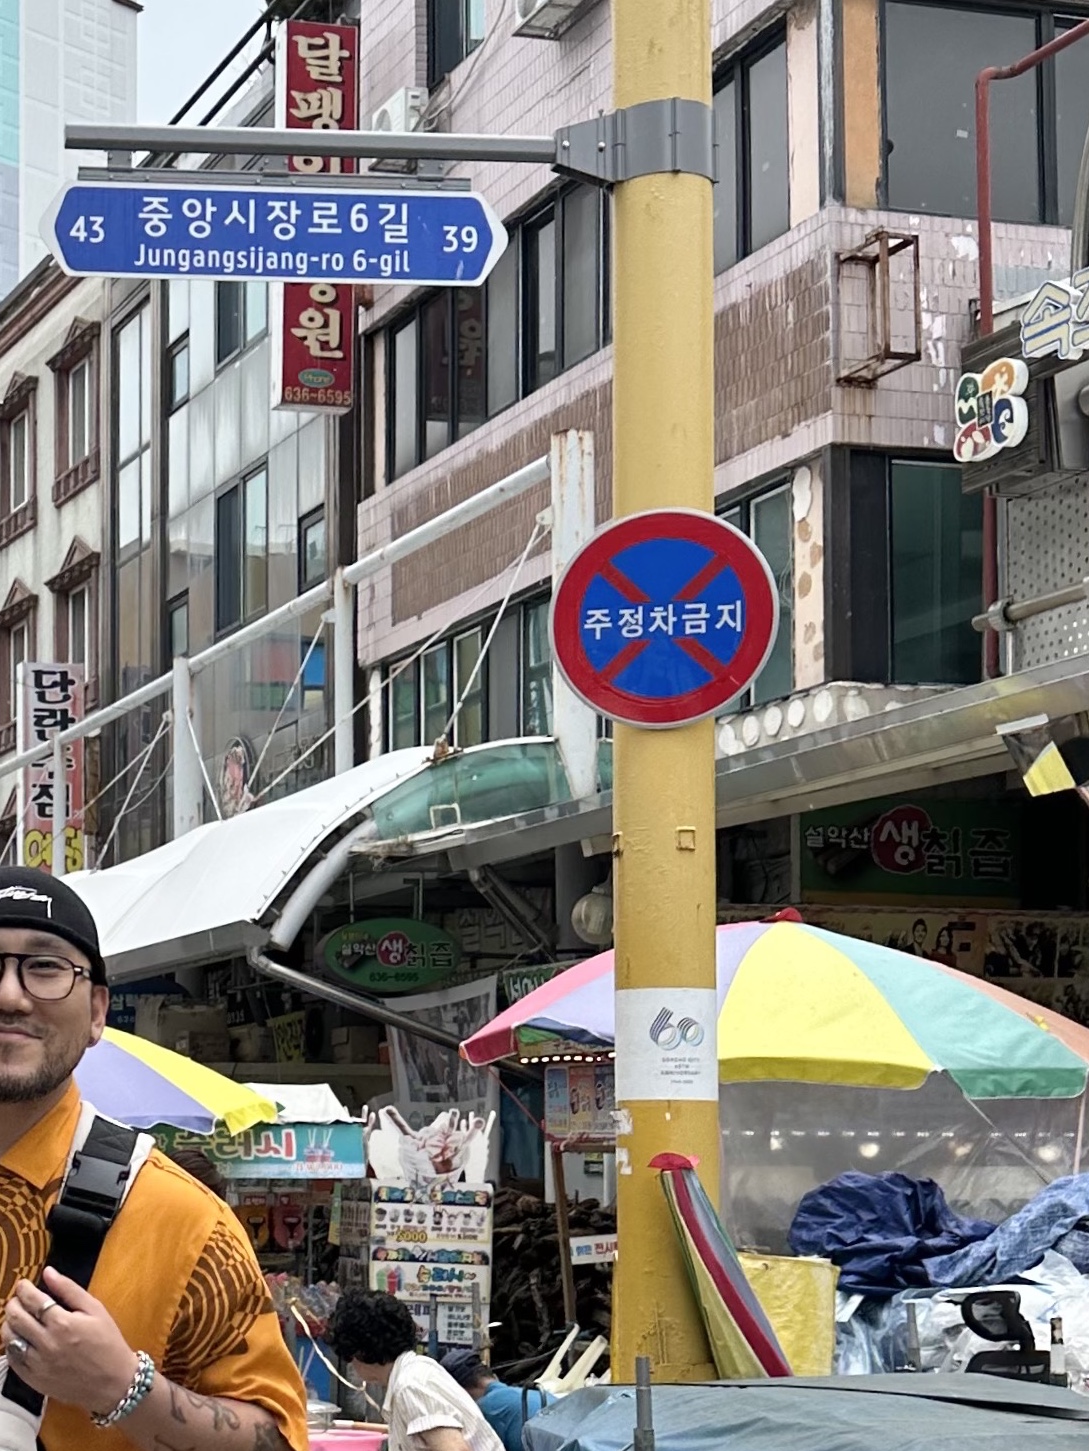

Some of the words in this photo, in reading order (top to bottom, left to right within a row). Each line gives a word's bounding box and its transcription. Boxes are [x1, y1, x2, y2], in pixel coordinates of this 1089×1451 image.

[69, 215, 105, 243] 43
[137, 197, 409, 244] 중앙시장로6길
[442, 226, 478, 252] 39
[134, 244, 345, 273] Jungangsijang-ro
[352, 250, 410, 276] 6-gil
[584, 600, 742, 640] 주정차금지
[805, 826, 871, 850] 설악산
[341, 942, 377, 957] 설악산
